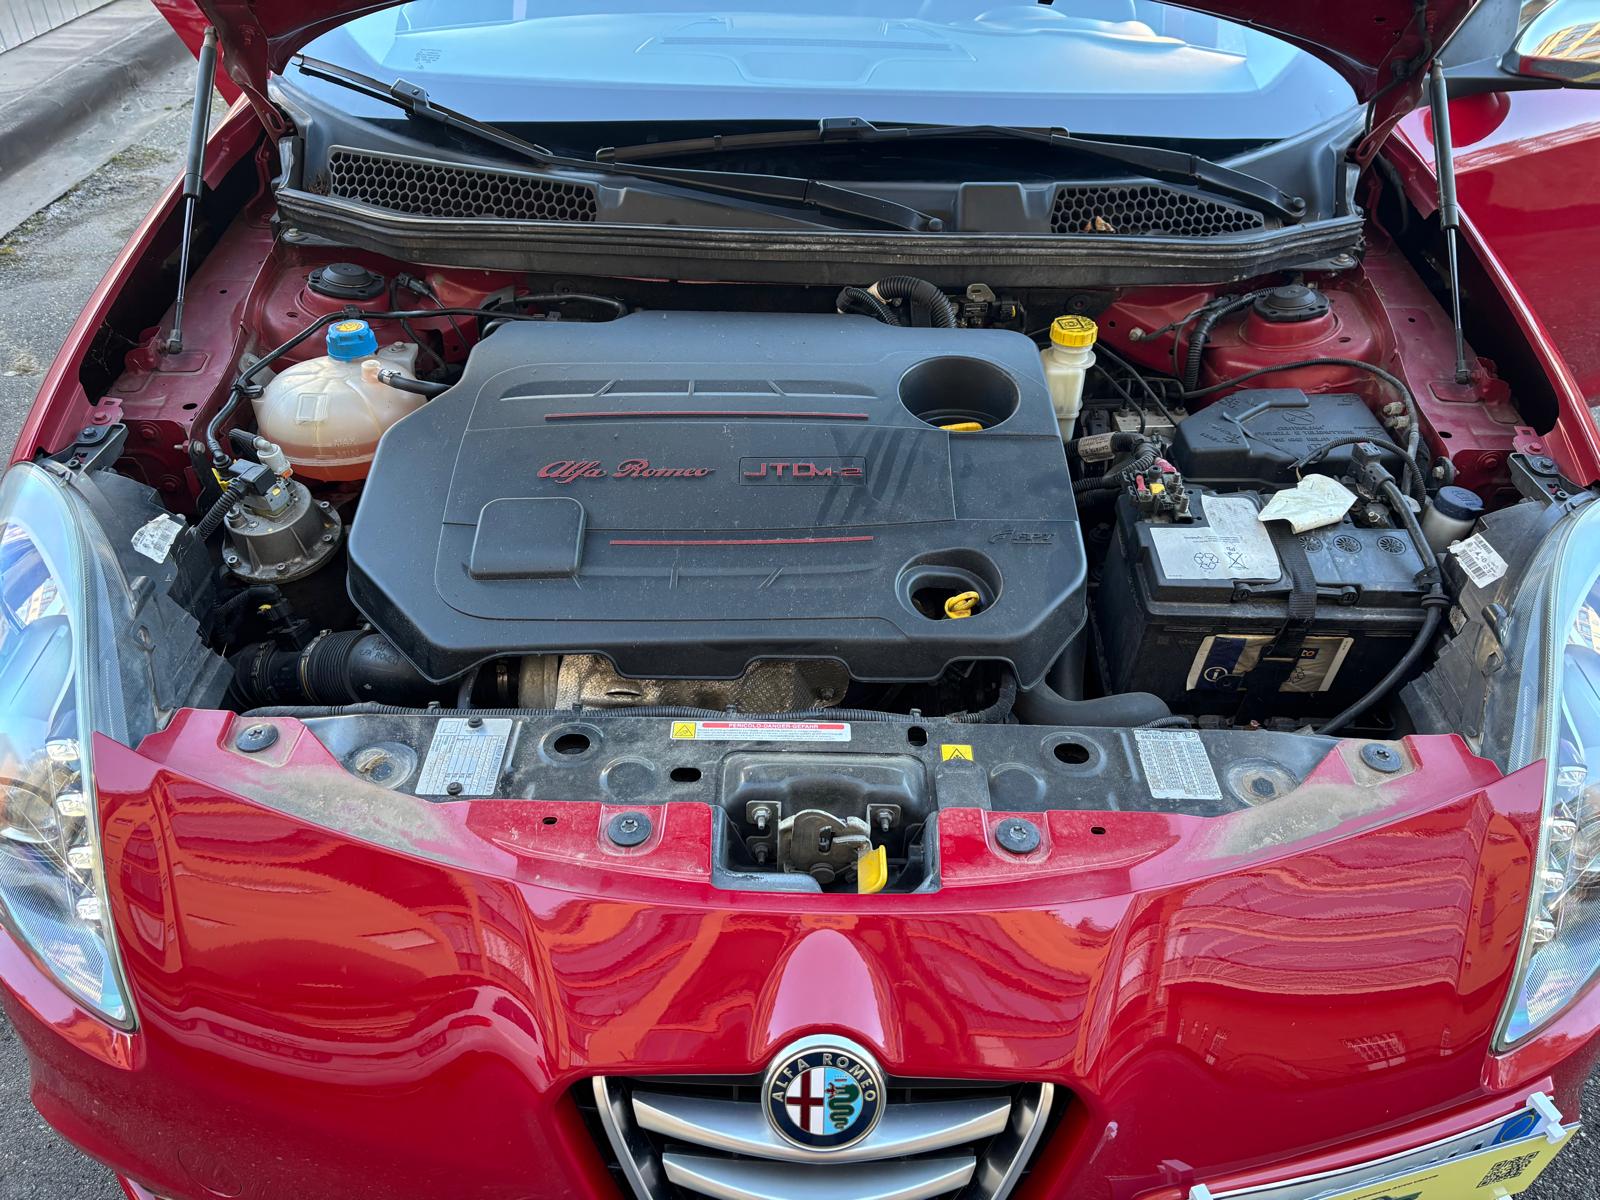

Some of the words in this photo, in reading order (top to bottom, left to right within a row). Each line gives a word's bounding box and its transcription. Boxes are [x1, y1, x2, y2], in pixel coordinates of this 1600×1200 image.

[537, 460, 608, 484] Alfa
[612, 458, 715, 479] Romeo
[772, 1058, 810, 1102] ALFA
[822, 1053, 877, 1102] ROMEO
